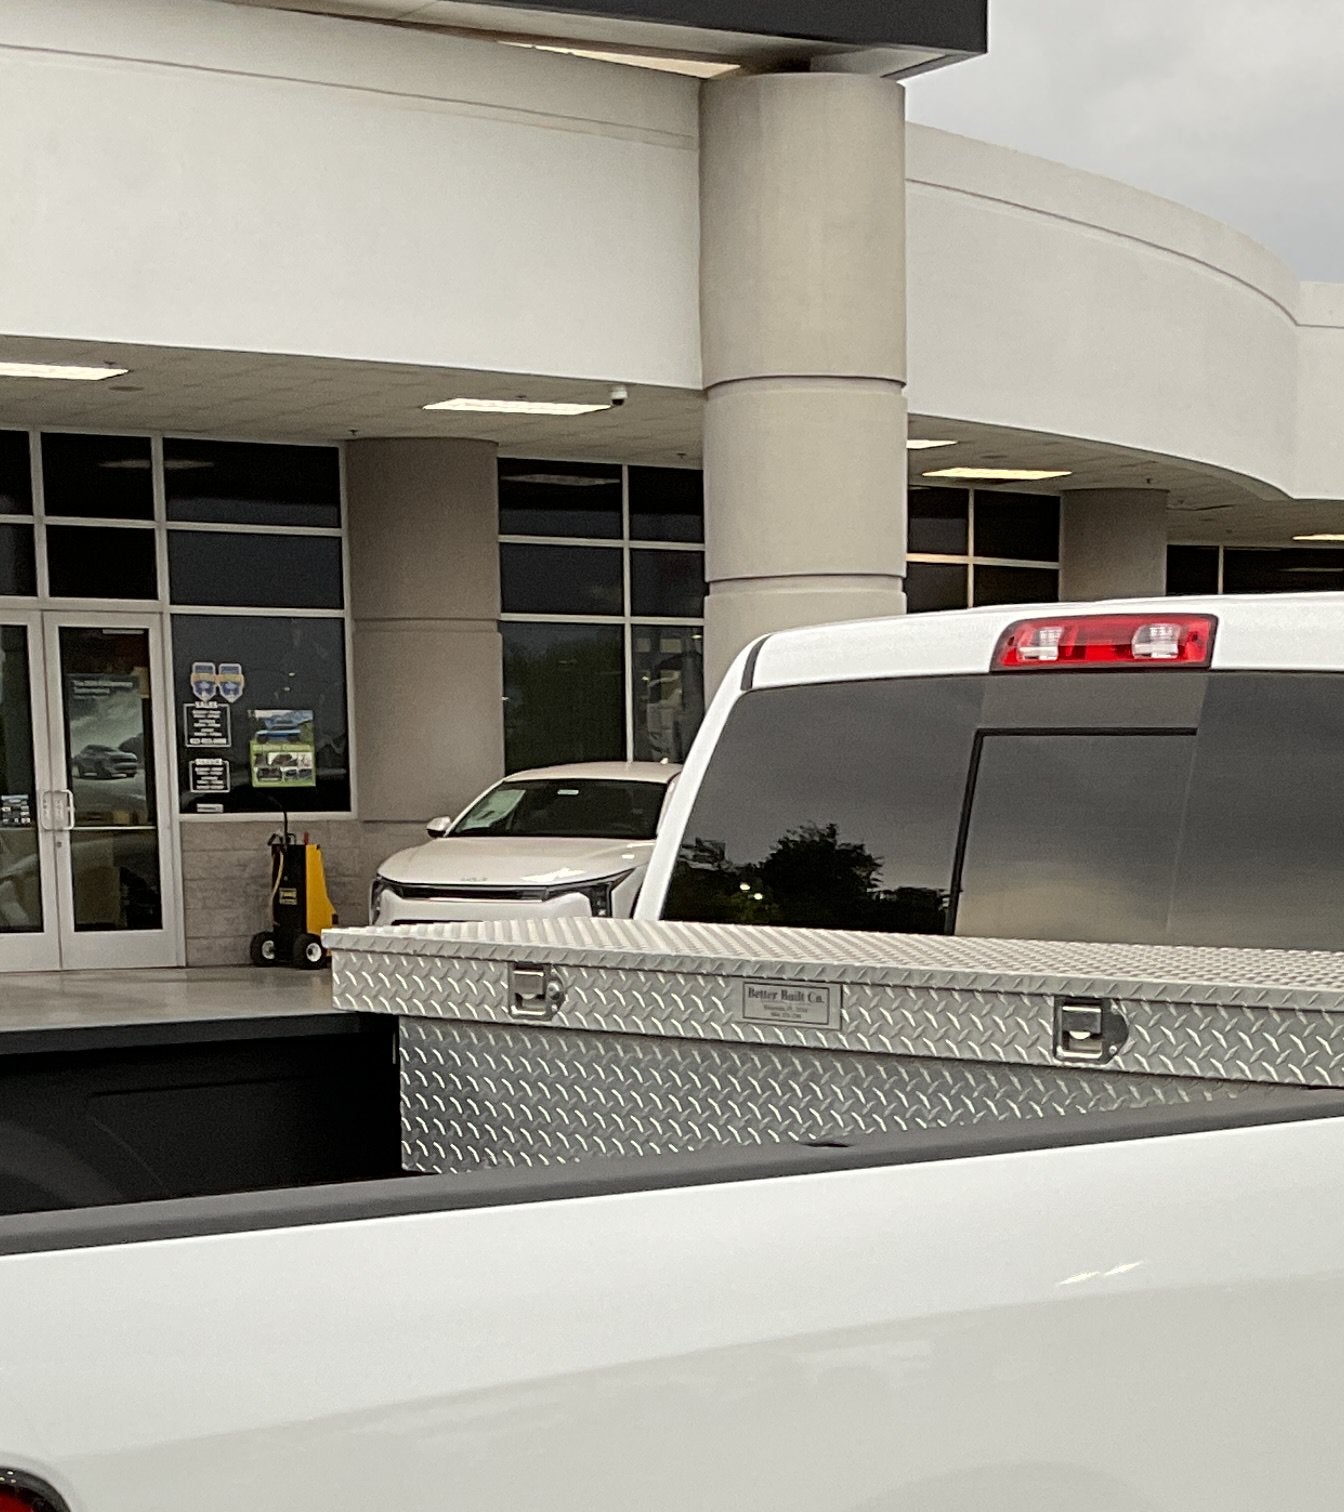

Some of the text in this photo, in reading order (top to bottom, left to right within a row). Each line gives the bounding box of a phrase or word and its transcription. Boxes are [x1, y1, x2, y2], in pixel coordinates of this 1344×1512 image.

[195, 701, 218, 709] SALES
[748, 987, 825, 1004] Better Built Co.
